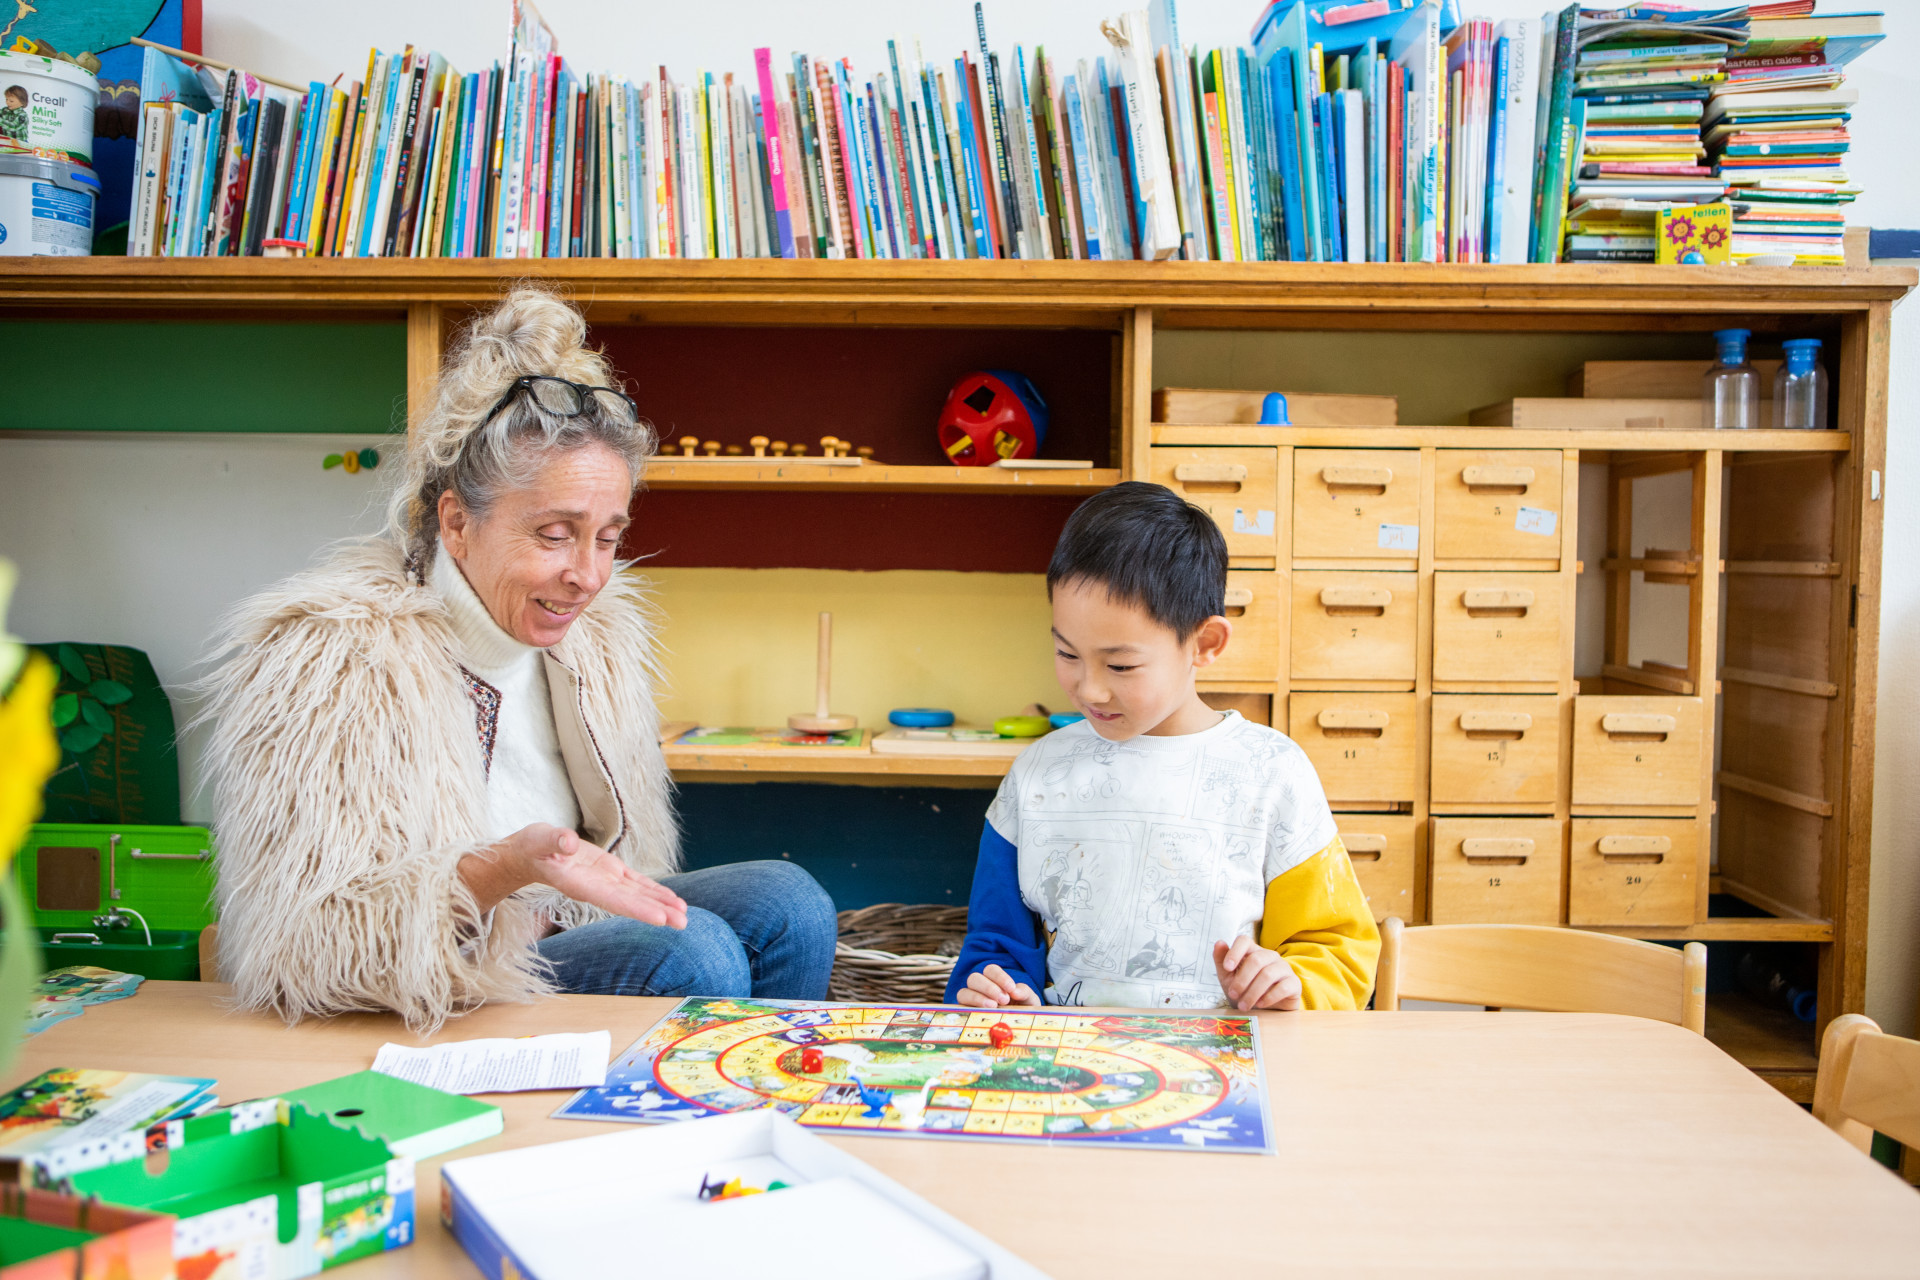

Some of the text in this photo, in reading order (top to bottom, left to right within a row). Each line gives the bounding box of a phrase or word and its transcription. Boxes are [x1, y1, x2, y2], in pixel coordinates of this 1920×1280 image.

[1672, 46, 1688, 54] feest
[1428, 41, 1437, 74] Velthuijs
[1508, 21, 1527, 94] Protocolen
[1761, 58, 1774, 66] en
[1774, 55, 1803, 65] cakes
[413, 77, 423, 99] Feest
[32, 92, 65, 107] Creall
[1128, 81, 1141, 119] Rupsje
[32, 106, 57, 119] Mini
[410, 99, 419, 116] met
[1428, 96, 1436, 118] grote
[32, 117, 63, 129] Silky Soft
[770, 136, 781, 176] Onderweg
[829, 124, 848, 201] SPEUREN IN HET BOS
[397, 149, 411, 189] Lucy Cousins
[1692, 207, 1727, 218] tellen
[1354, 507, 1362, 516] 2
[1351, 628, 1358, 638] 7
[1344, 749, 1356, 759] 11
[1488, 877, 1501, 888] 12
[1626, 876, 1642, 886] 20
